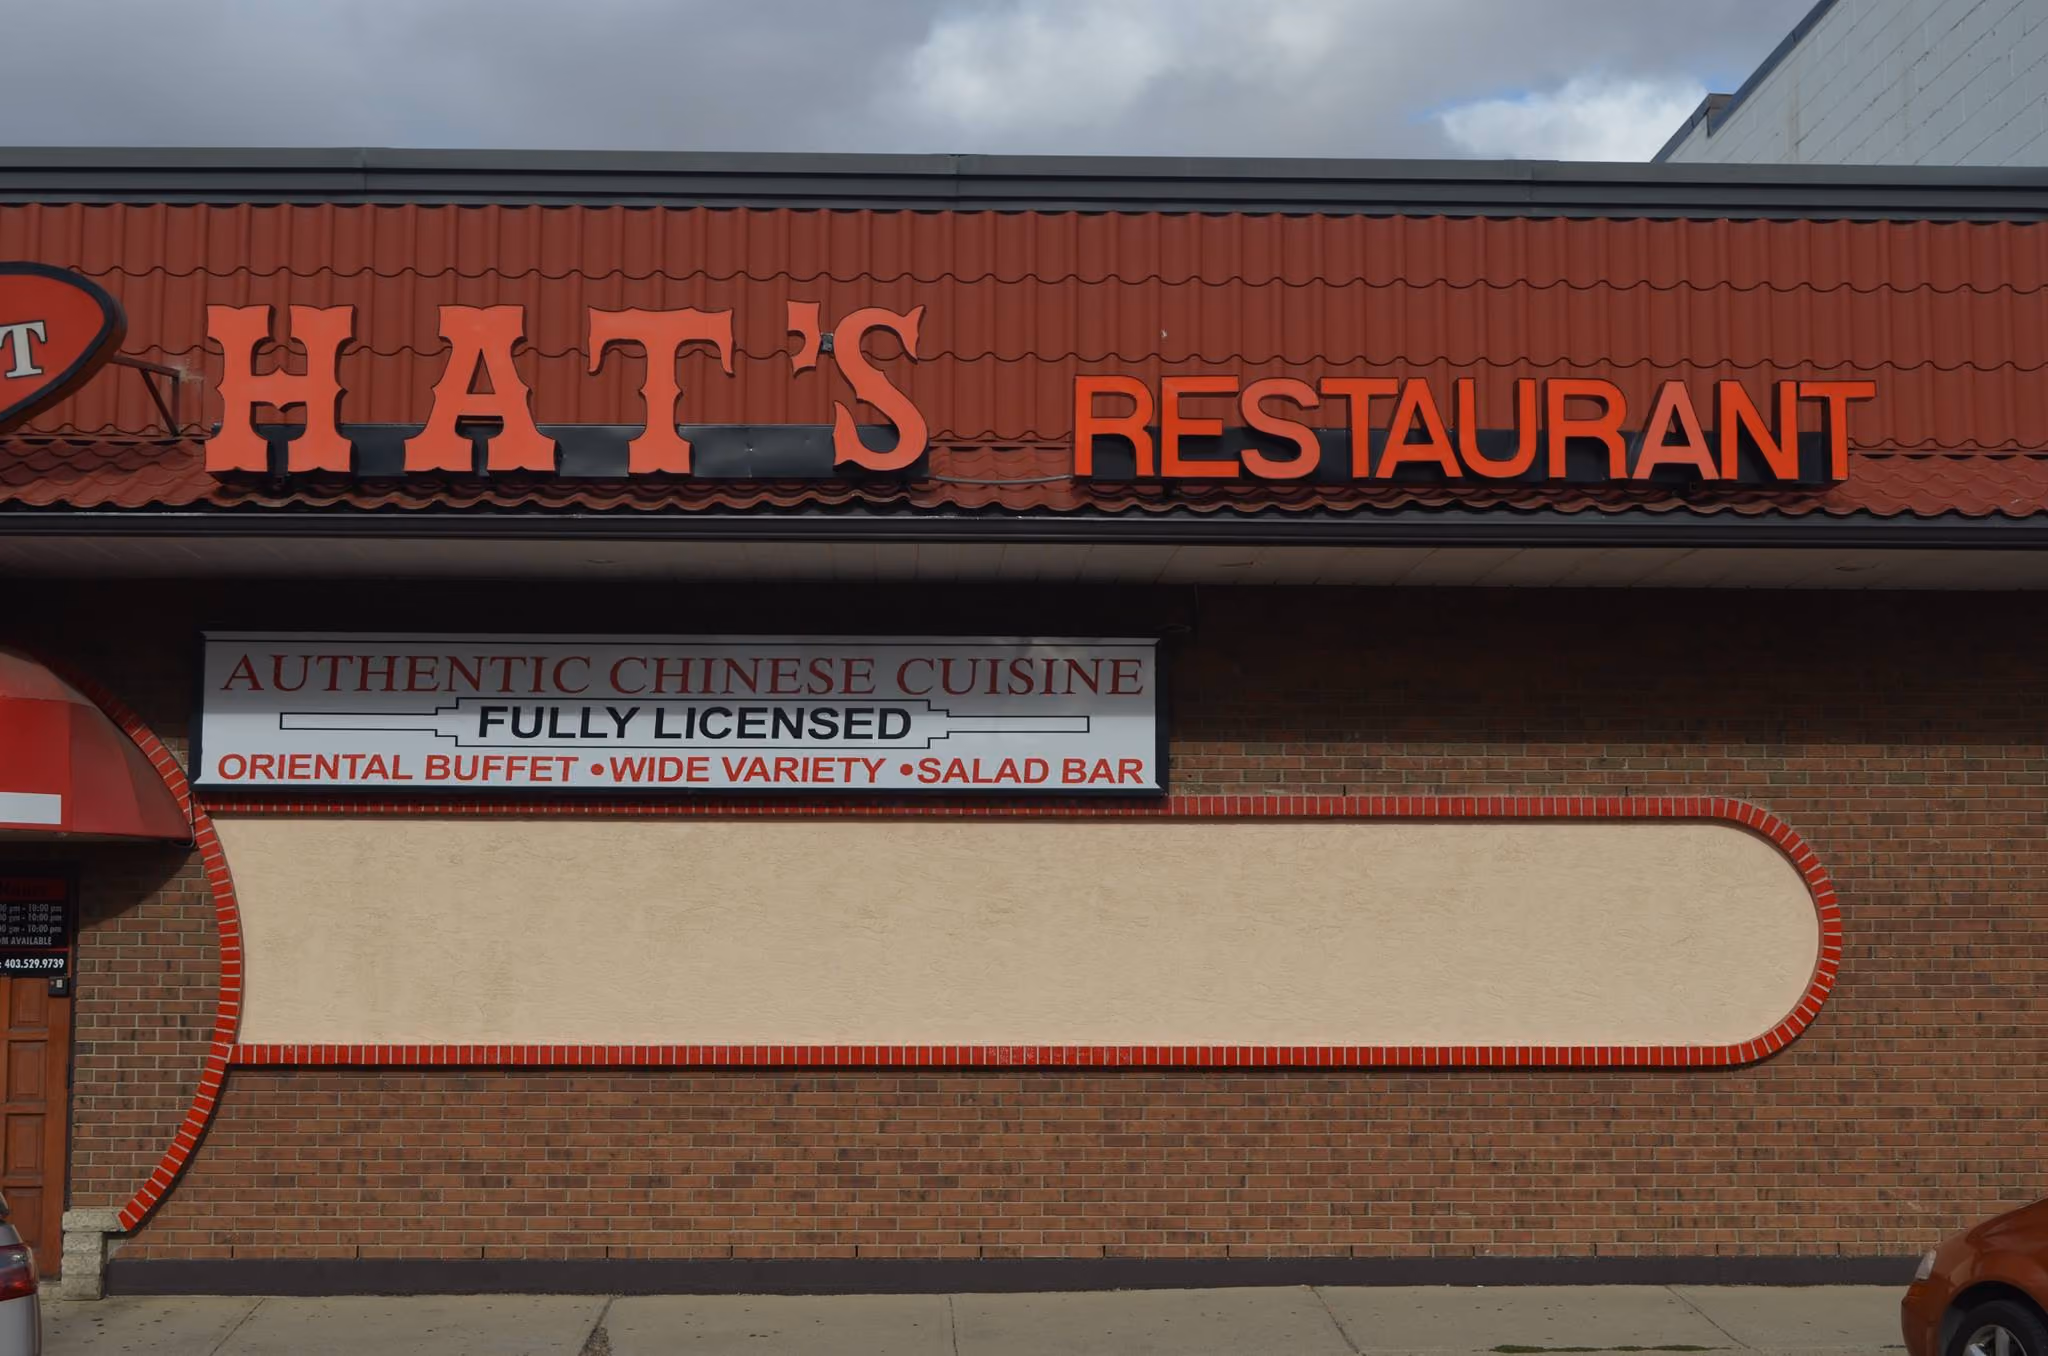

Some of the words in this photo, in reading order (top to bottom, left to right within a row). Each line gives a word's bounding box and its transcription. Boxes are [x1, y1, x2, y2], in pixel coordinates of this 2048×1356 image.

[205, 301, 927, 473] HAT'S
[1074, 375, 1876, 480] RESTAURANT
[219, 653, 592, 693] AUTHENTIC
[609, 655, 877, 695] CHINESE
[896, 657, 1145, 696] CUISINE
[478, 705, 641, 739] FULLY
[654, 706, 913, 740] LICENSED
[217, 753, 414, 781] ORIENTAL
[424, 754, 579, 782] BUFFET
[721, 756, 887, 784] VARIETY
[1061, 757, 1145, 785] BAR
[10, 936, 52, 945] AVAILABLE
[4, 958, 65, 969] 403.529.9739
